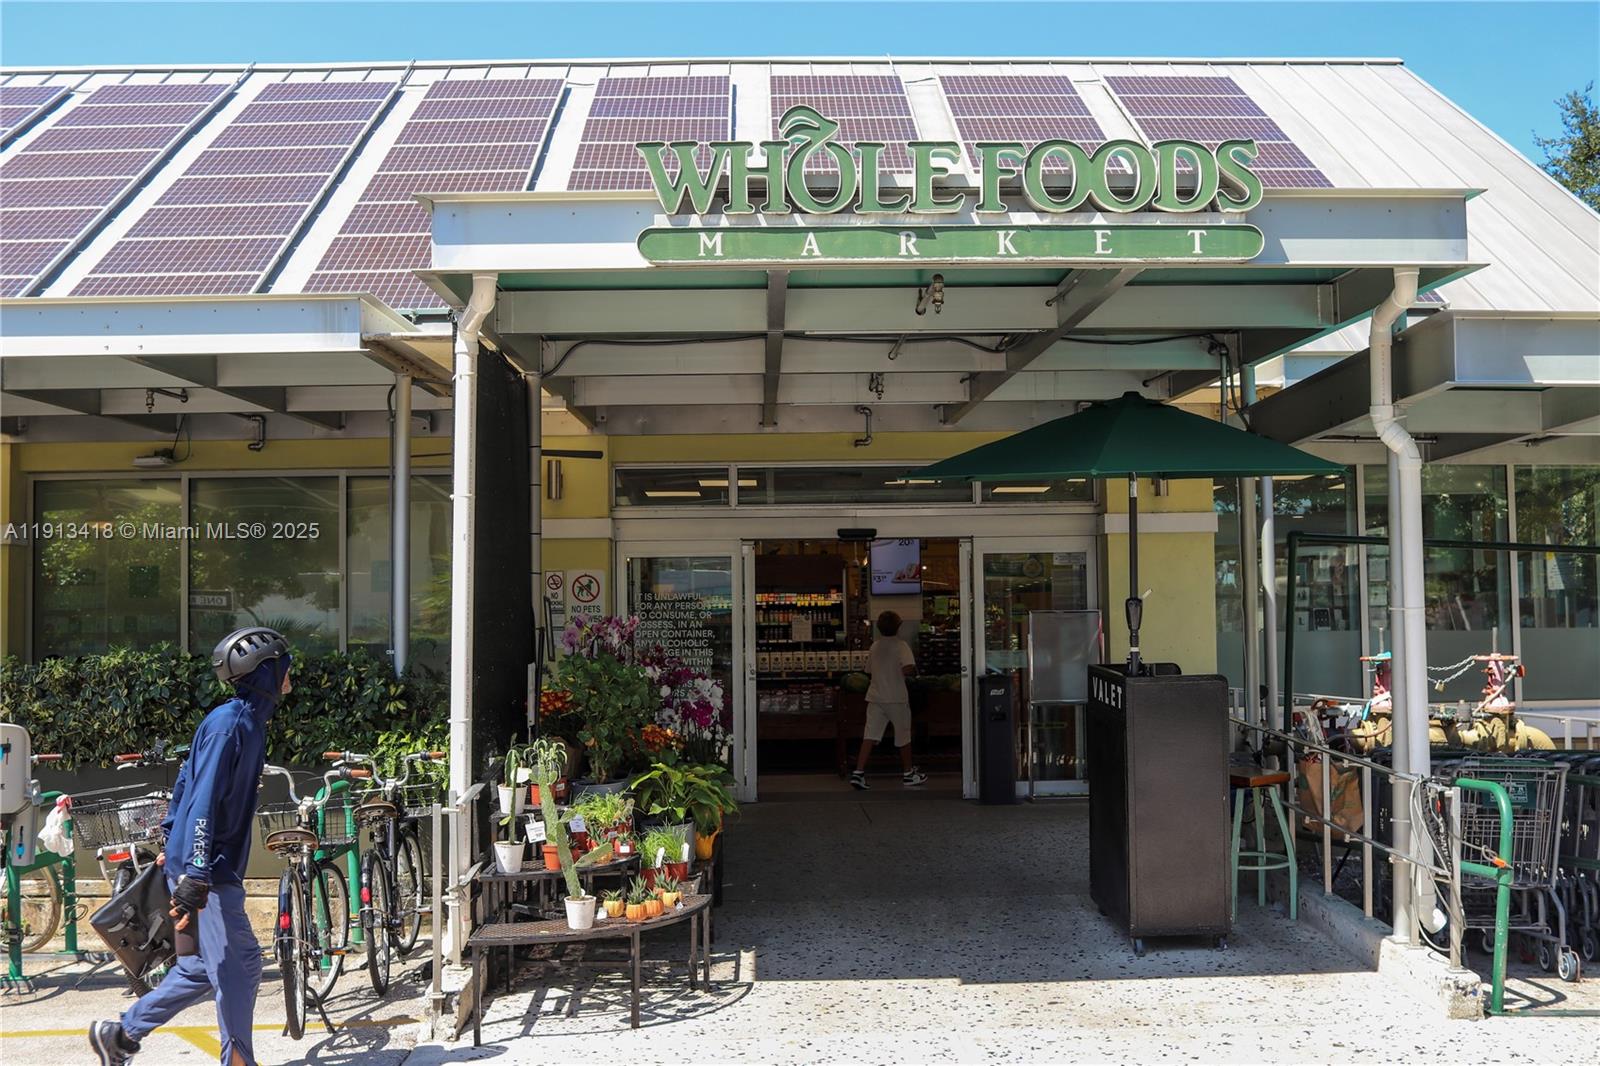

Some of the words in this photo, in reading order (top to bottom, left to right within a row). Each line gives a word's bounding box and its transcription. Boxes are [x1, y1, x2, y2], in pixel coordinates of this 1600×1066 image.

[635, 105, 965, 215] WHOLE
[974, 138, 1264, 214] FOODS
[698, 230, 1208, 257] MARKET
[644, 593, 652, 601] IS
[571, 605, 581, 613] NO
[583, 605, 601, 613] PETS
[634, 602, 652, 610] FOR
[653, 602, 673, 610] ANY
[648, 611, 698, 620] CONSUME,
[699, 611, 712, 619] OR
[634, 621, 677, 629] OSSESS,
[677, 620, 687, 628] IN
[689, 620, 703, 628] AN
[634, 630, 659, 638] OPEN
[660, 630, 715, 639] CONTAINER,
[634, 639, 654, 647] ANY
[655, 639, 709, 647] ALCOHOLIC
[682, 649, 692, 657] IN
[694, 649, 714, 657] THIS
[1092, 676, 1122, 710] VALET
